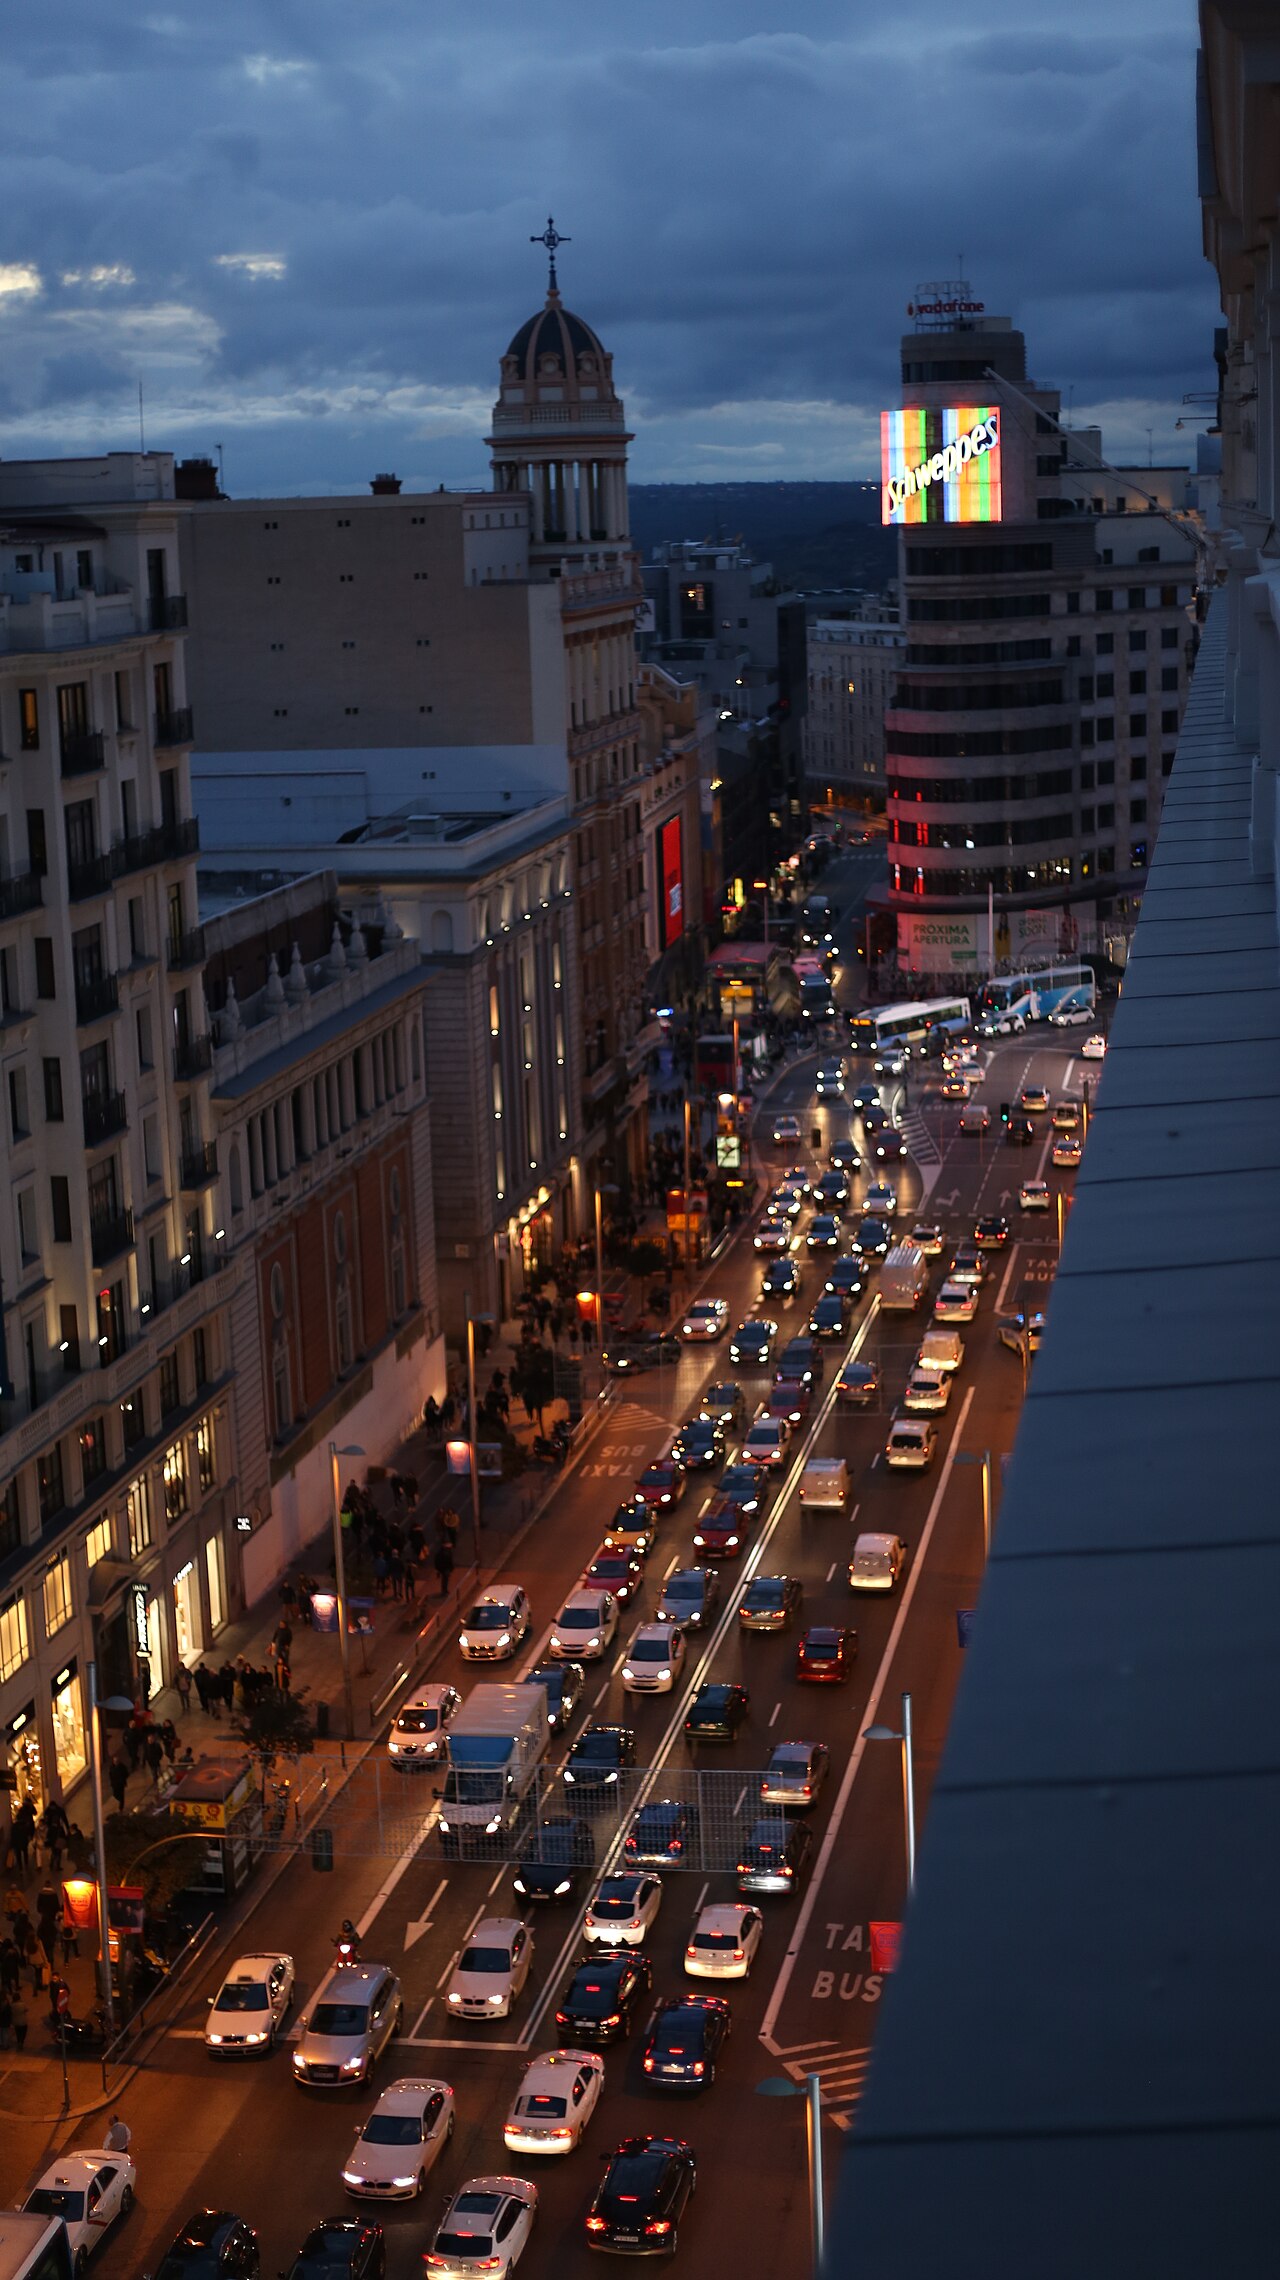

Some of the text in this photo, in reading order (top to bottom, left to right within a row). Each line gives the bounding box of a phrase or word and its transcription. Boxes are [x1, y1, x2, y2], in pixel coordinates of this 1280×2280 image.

[917, 299, 985, 313] vodafone
[887, 414, 998, 516] Schweppes
[912, 935, 970, 945] APERTURA
[600, 1445, 646, 1457] BUS
[579, 1463, 634, 1477] TAXI
[811, 1970, 884, 2003] BUS
